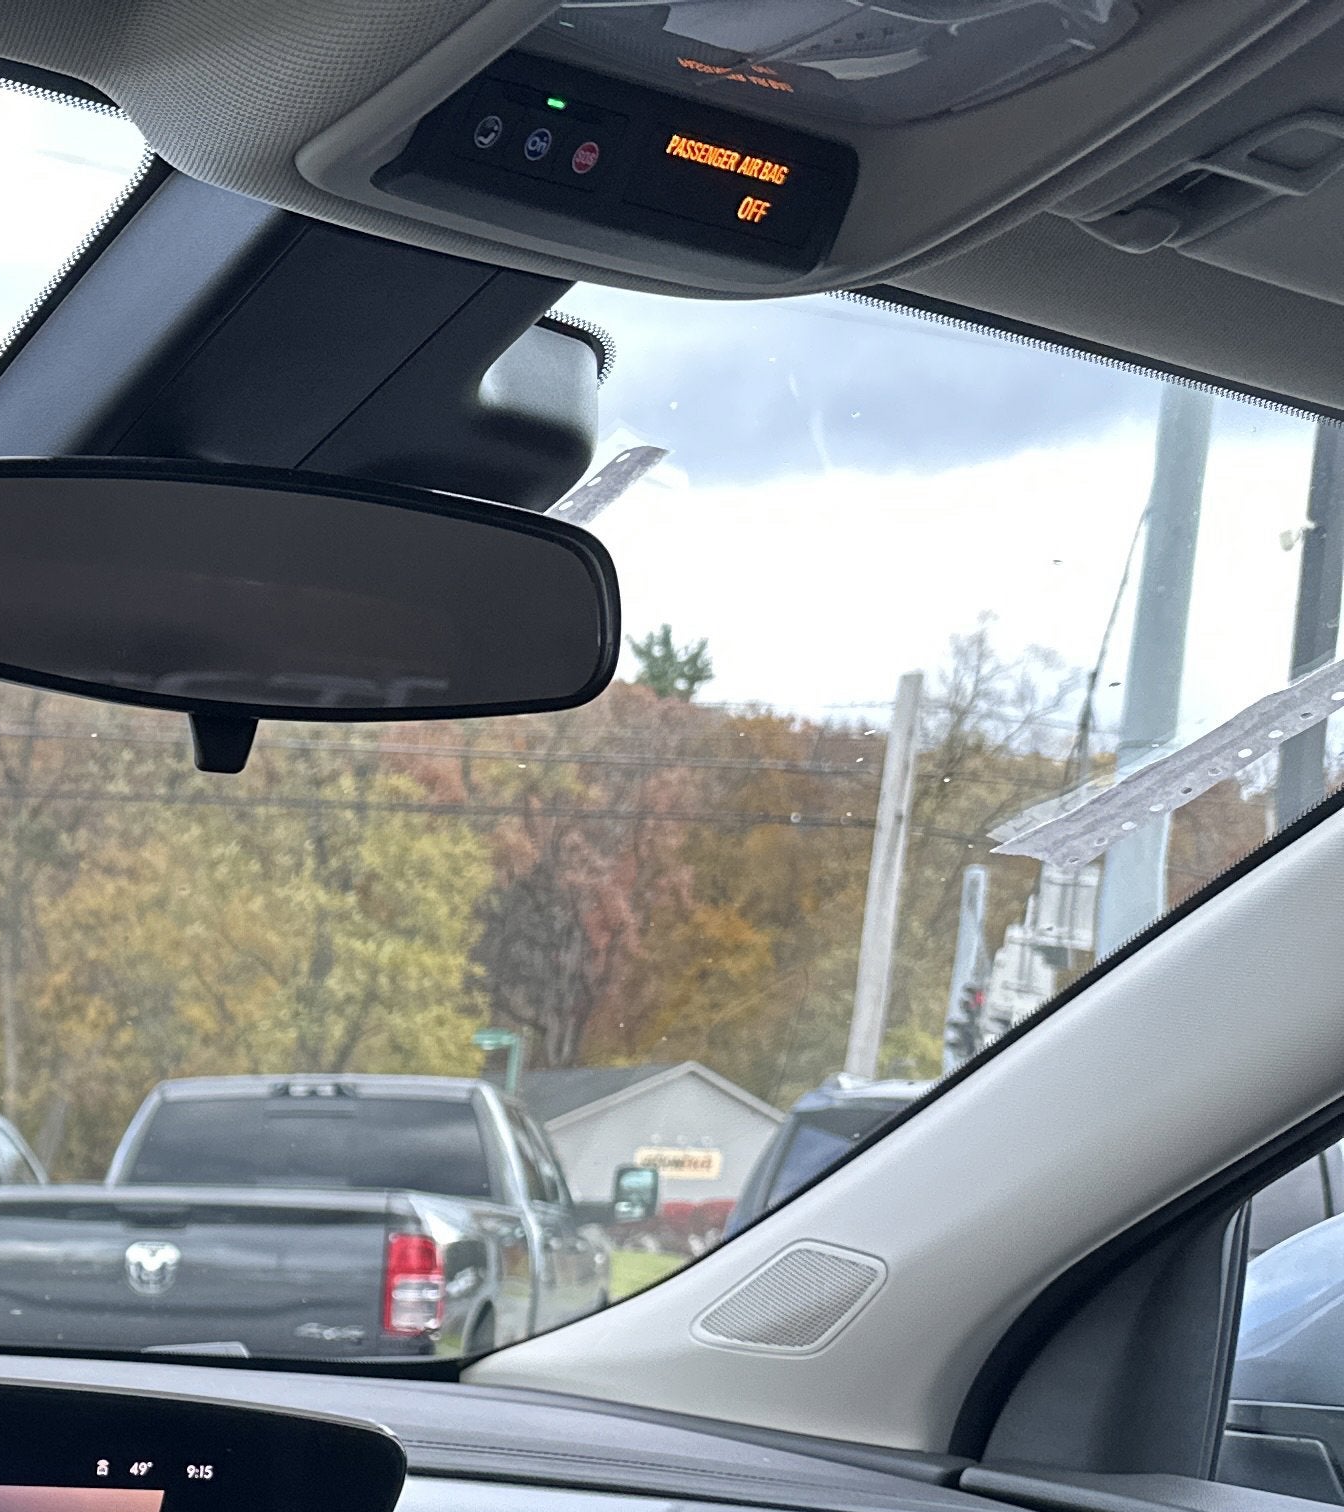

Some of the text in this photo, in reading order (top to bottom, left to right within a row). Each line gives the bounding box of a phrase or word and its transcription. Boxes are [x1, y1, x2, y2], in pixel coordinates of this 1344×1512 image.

[666, 134, 740, 171] PASSENGER
[759, 160, 790, 185] BAG
[737, 196, 771, 223] OFF
[129, 1461, 153, 1476] 49°
[186, 1464, 214, 1479] 9:15
